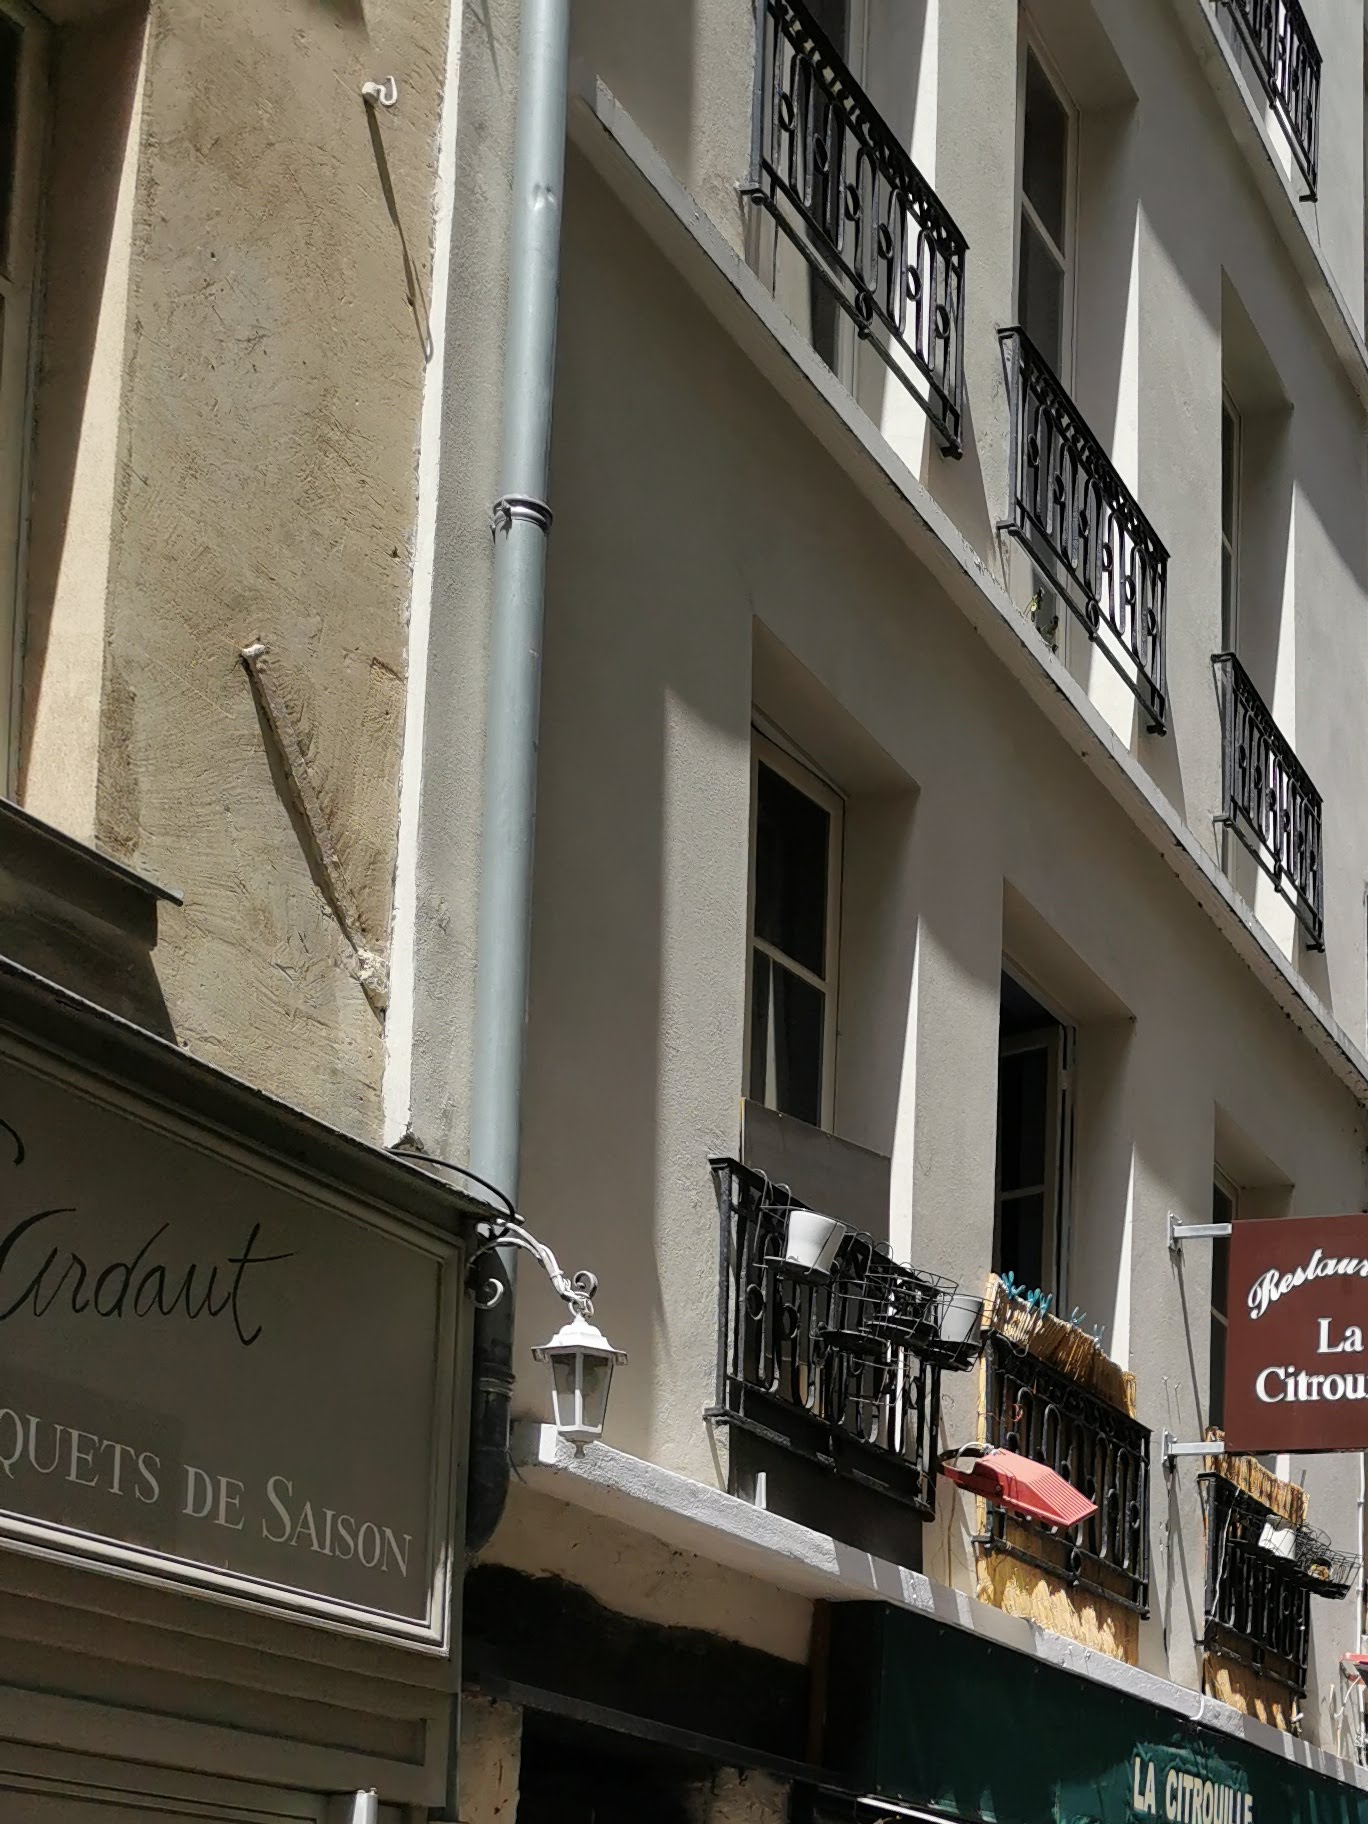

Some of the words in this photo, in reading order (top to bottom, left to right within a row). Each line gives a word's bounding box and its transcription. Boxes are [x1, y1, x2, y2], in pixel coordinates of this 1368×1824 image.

[1316, 1317, 1365, 1353] La
[181, 1463, 246, 1531] DE
[1133, 1756, 1156, 1816] LA
